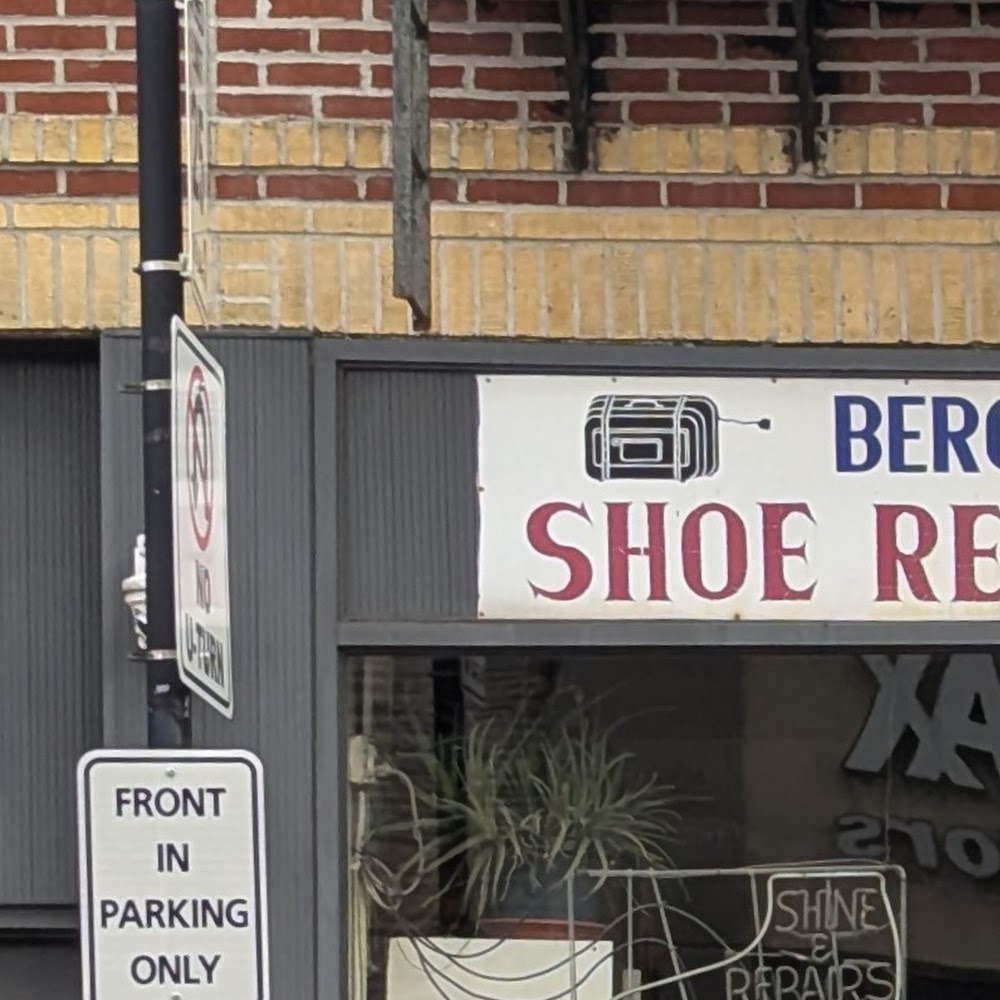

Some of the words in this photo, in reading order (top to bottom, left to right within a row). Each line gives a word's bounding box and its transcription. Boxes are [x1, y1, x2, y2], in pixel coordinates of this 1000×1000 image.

[526, 502, 818, 602] SHOE
[185, 612, 225, 689] U-TURN
[116, 787, 226, 816] FRONT
[157, 843, 189, 872] IN
[100, 899, 249, 929] PARKING
[775, 887, 878, 932] SHINE
[130, 954, 221, 984] ONLY
